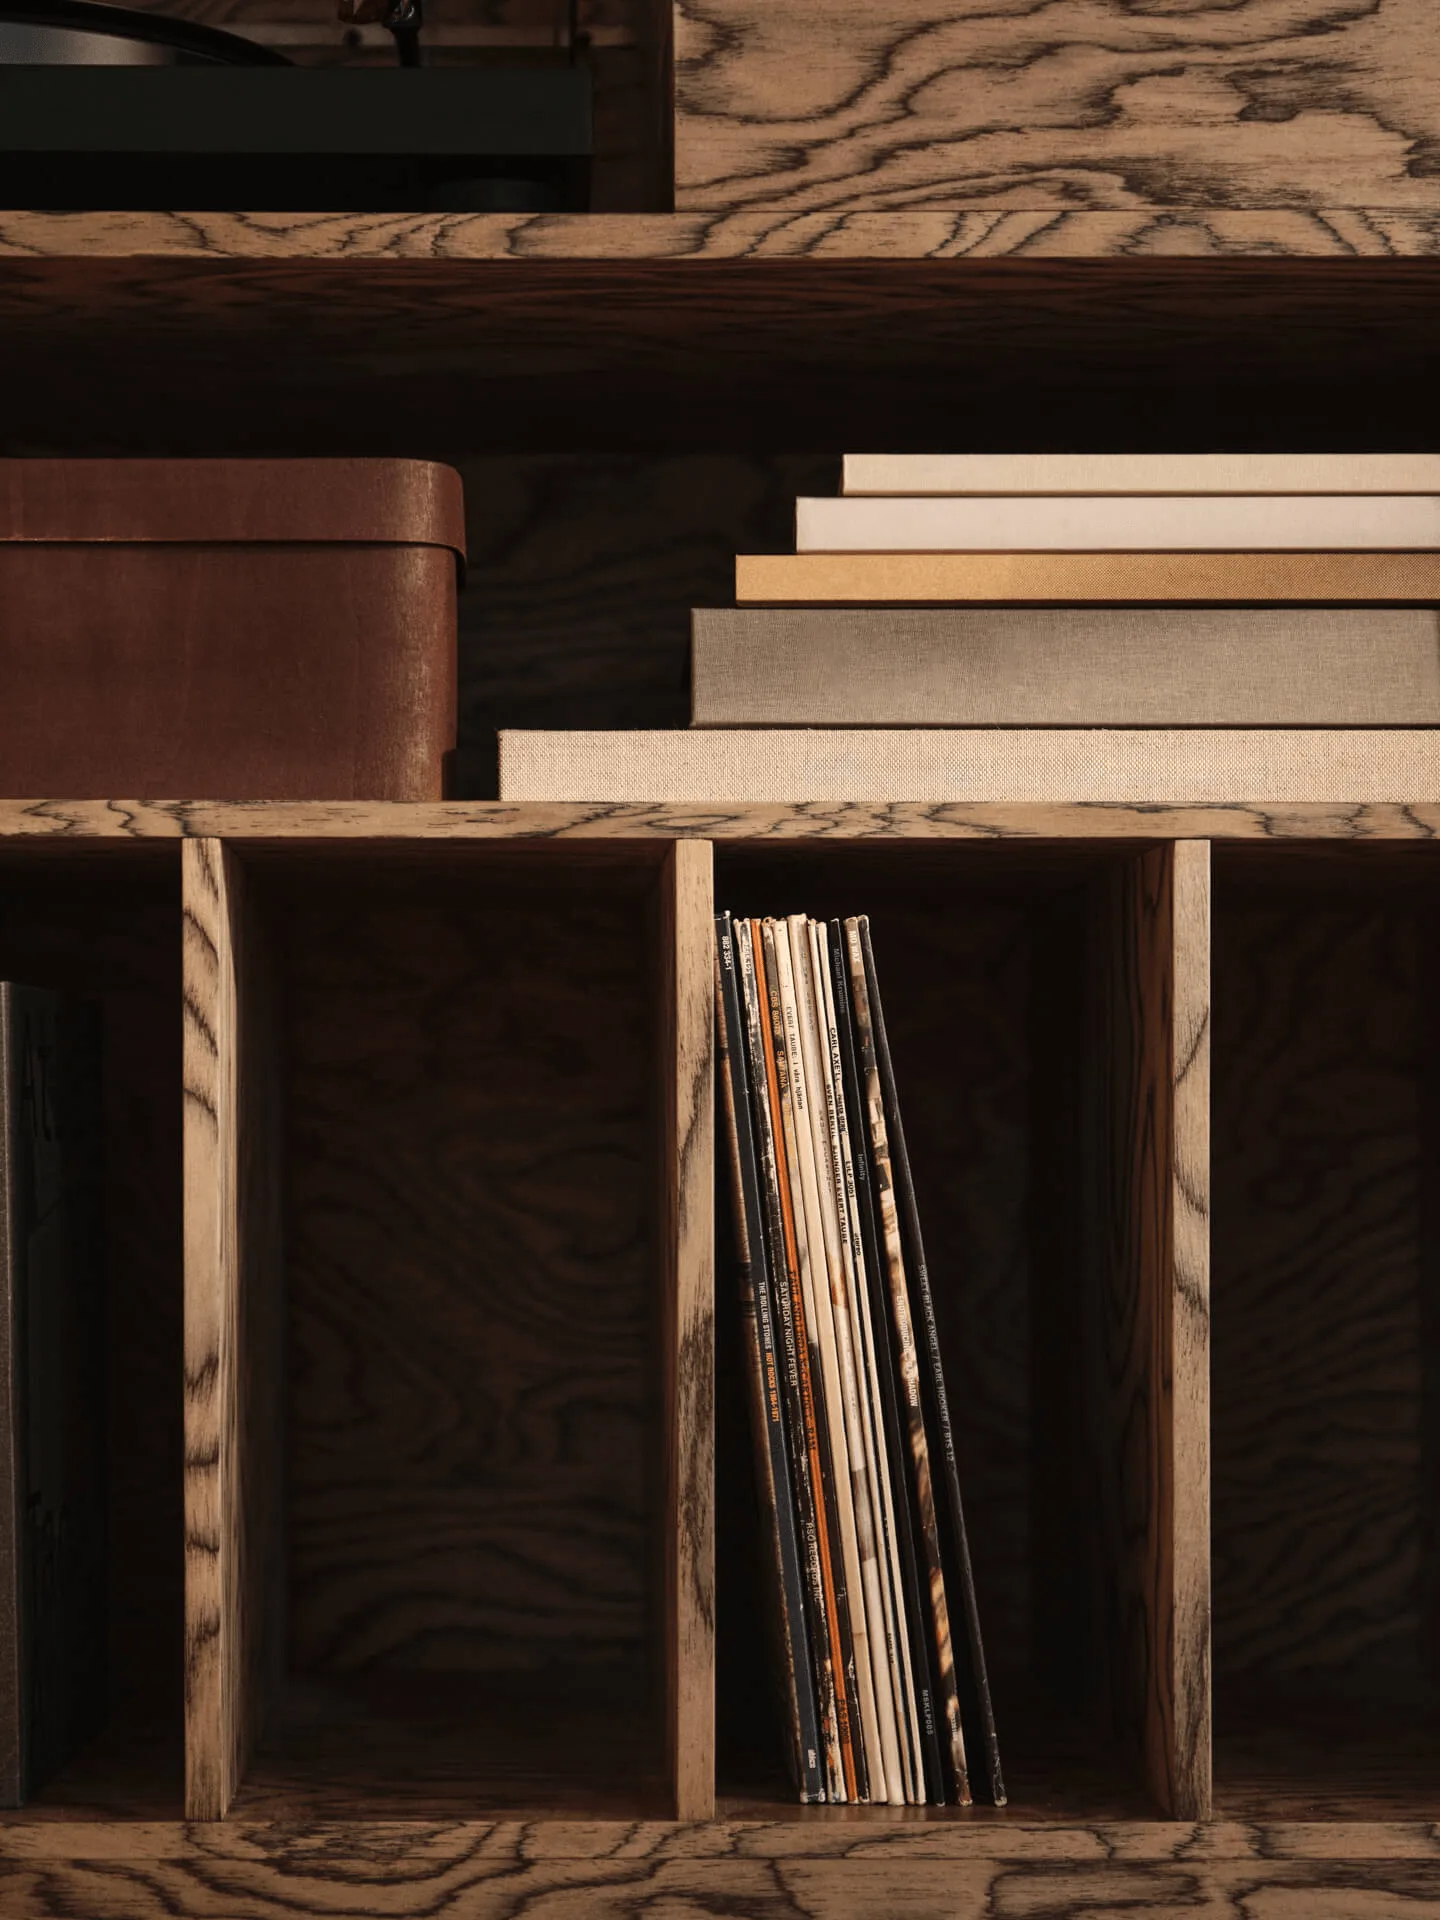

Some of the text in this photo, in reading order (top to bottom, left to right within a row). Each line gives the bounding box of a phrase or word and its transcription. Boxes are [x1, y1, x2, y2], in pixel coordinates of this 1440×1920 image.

[831, 948, 843, 978] Michael
[769, 990, 778, 1007] CBS
[785, 1006, 794, 1028] EVERT
[828, 1027, 838, 1050] CARL
[775, 1050, 787, 1088] SANTANA
[792, 1068, 801, 1082] våra
[793, 1086, 804, 1109] hjärtan
[825, 1084, 833, 1105] SVEN
[855, 1153, 867, 1180] Infinity
[835, 1187, 844, 1212] EVERT
[839, 1217, 848, 1244] TAUBE
[757, 1281, 766, 1293] THE
[917, 1264, 929, 1292] SWEET
[758, 1295, 769, 1322] ROLLING
[921, 1294, 934, 1322] BLACK
[761, 1324, 772, 1349] STONES
[777, 1281, 797, 1385] SATURDAY NIGHT FEVER
[926, 1325, 938, 1351] ANGEL
[764, 1352, 773, 1365] HOT
[766, 1367, 776, 1388] ROCKS
[931, 1362, 943, 1383] EARL
[935, 1387, 949, 1421] HOOKER
